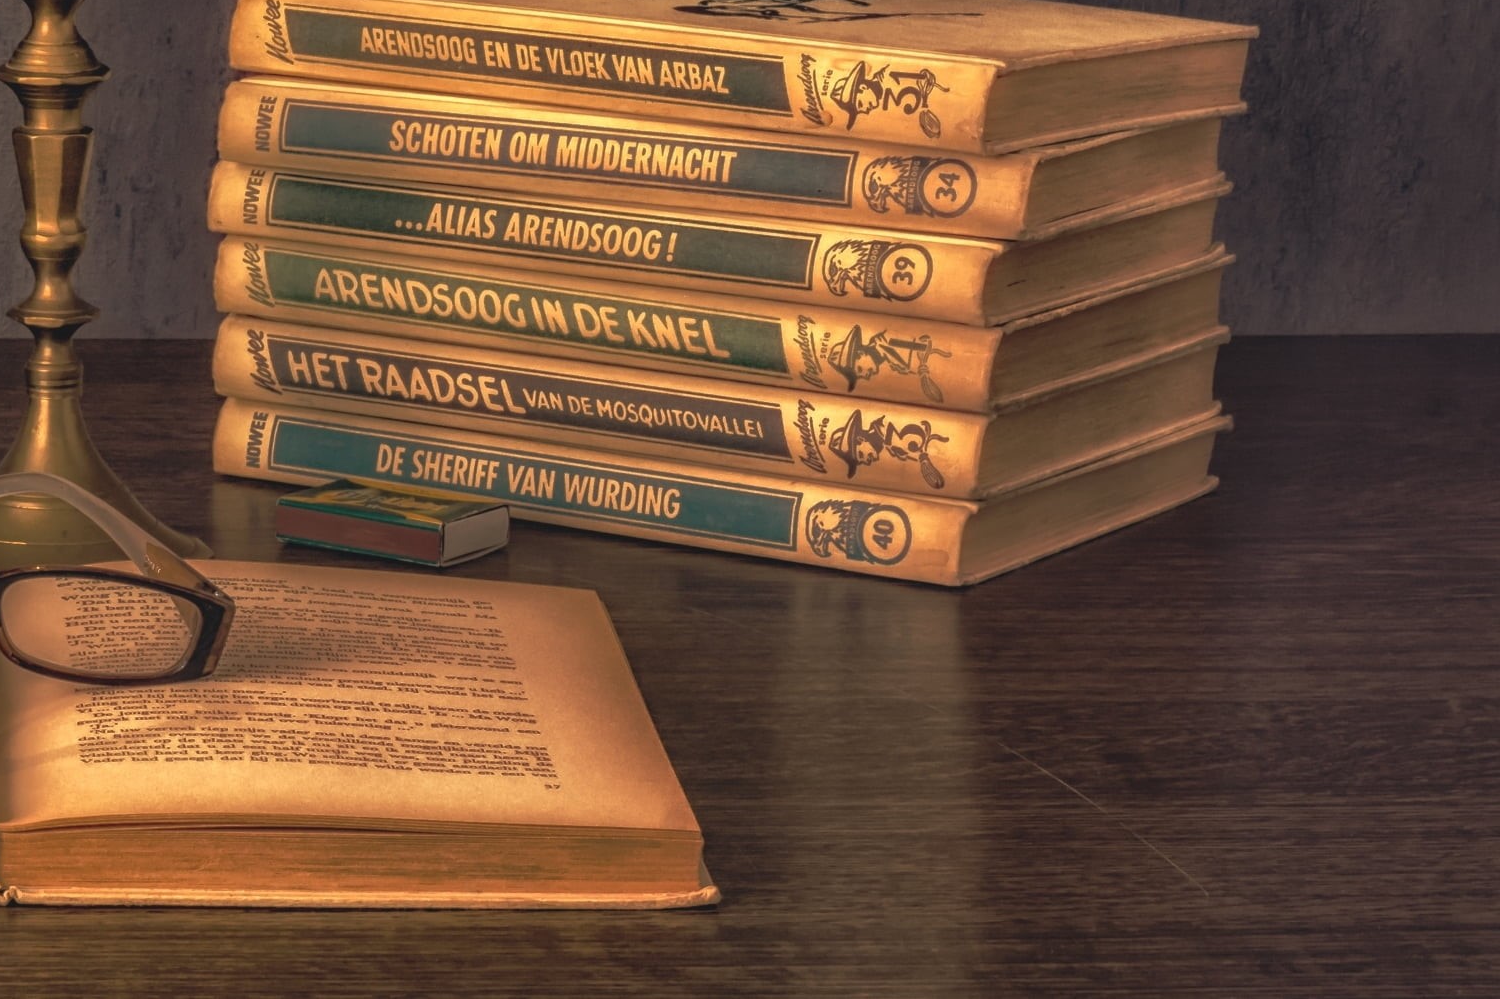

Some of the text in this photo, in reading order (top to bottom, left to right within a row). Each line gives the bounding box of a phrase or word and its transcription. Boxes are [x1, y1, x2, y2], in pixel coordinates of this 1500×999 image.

[360, 26, 729, 94] ARENDSOOG EN DE VLOEK VAN ARBAZ
[821, 69, 833, 96] serie
[797, 53, 825, 126] Arendsoog
[882, 71, 926, 115] 31
[255, 96, 278, 152] NOWEE
[389, 120, 737, 183] SCHOTEN OM MIDDERNACHT
[243, 169, 266, 224] NOWEE
[935, 172, 960, 202] 34
[395, 202, 497, 240] ...ALIAS
[866, 244, 881, 294] ARENDSOOG
[892, 256, 916, 285] 39
[315, 268, 729, 358] ARENDSOOG IN DE KNEL
[793, 314, 828, 389] Arendsoog
[820, 332, 831, 359] serie
[288, 350, 764, 438] HET RAADSEL VAN DE MOSQUITOVALLEI
[246, 411, 269, 468] NOWEE
[793, 399, 828, 473] Arendsoog
[819, 417, 830, 445] serie
[376, 444, 680, 519] DE SHERIFF VAN WURDING
[872, 519, 895, 550] 40
[61, 593, 110, 601] Wong
[77, 717, 129, 725] gesprek
